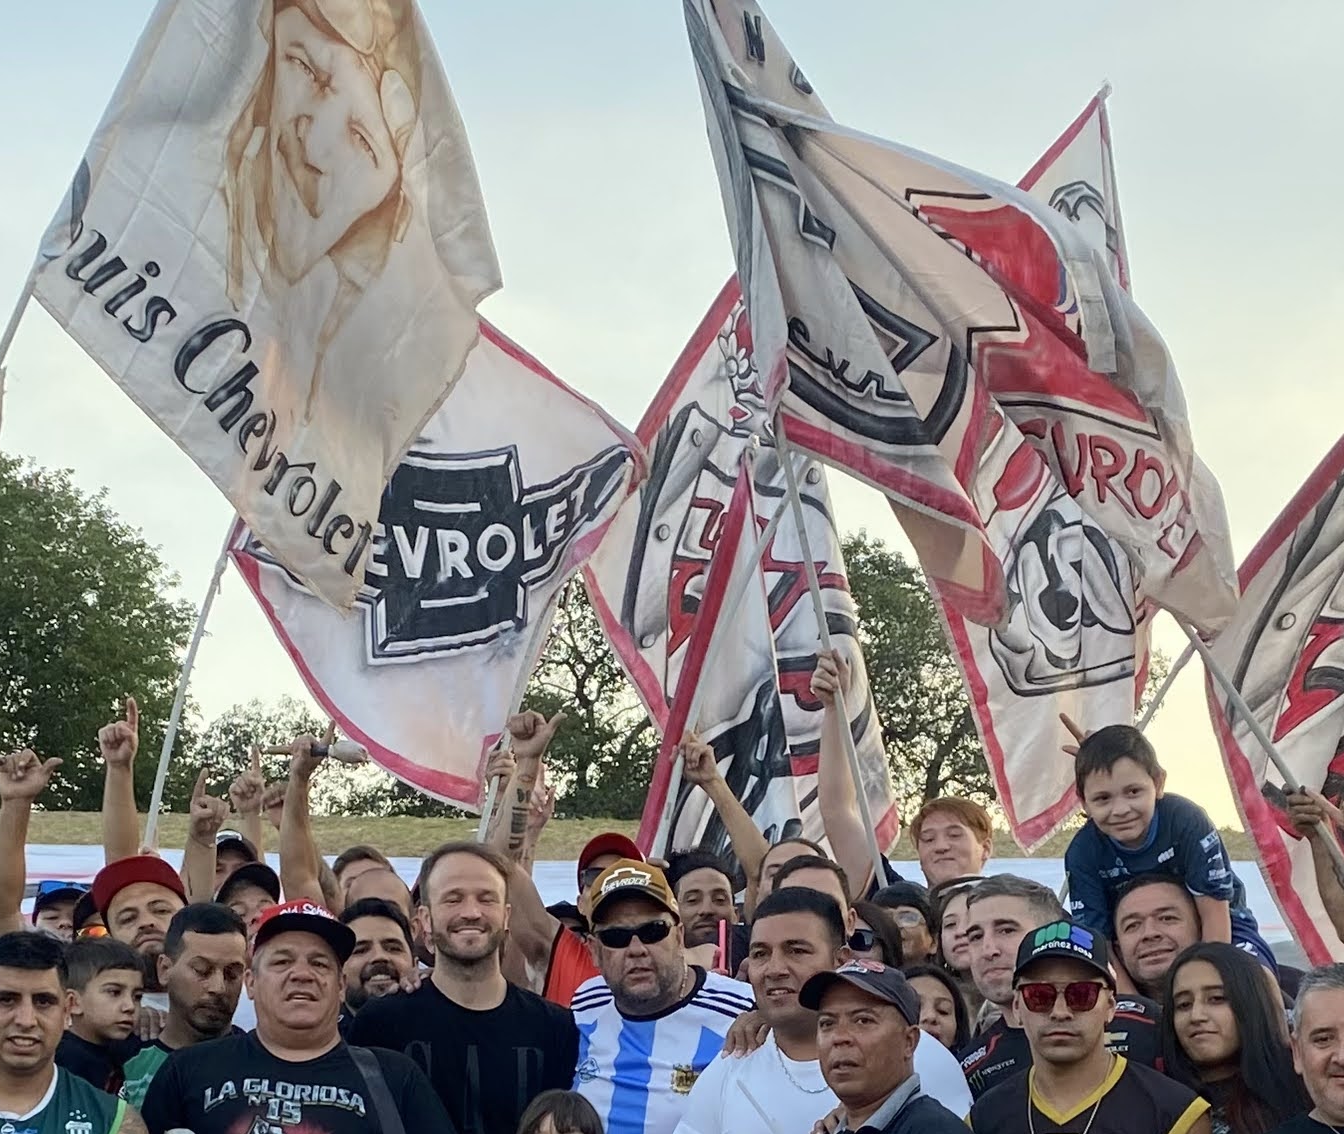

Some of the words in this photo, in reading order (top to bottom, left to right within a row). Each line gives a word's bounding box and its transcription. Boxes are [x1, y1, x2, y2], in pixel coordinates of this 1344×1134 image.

[173, 316, 373, 578] Chevrolet
[366, 477, 593, 580] EVROLET
[204, 1081, 238, 1113] LA
[242, 1077, 367, 1118] GLORIOSA
